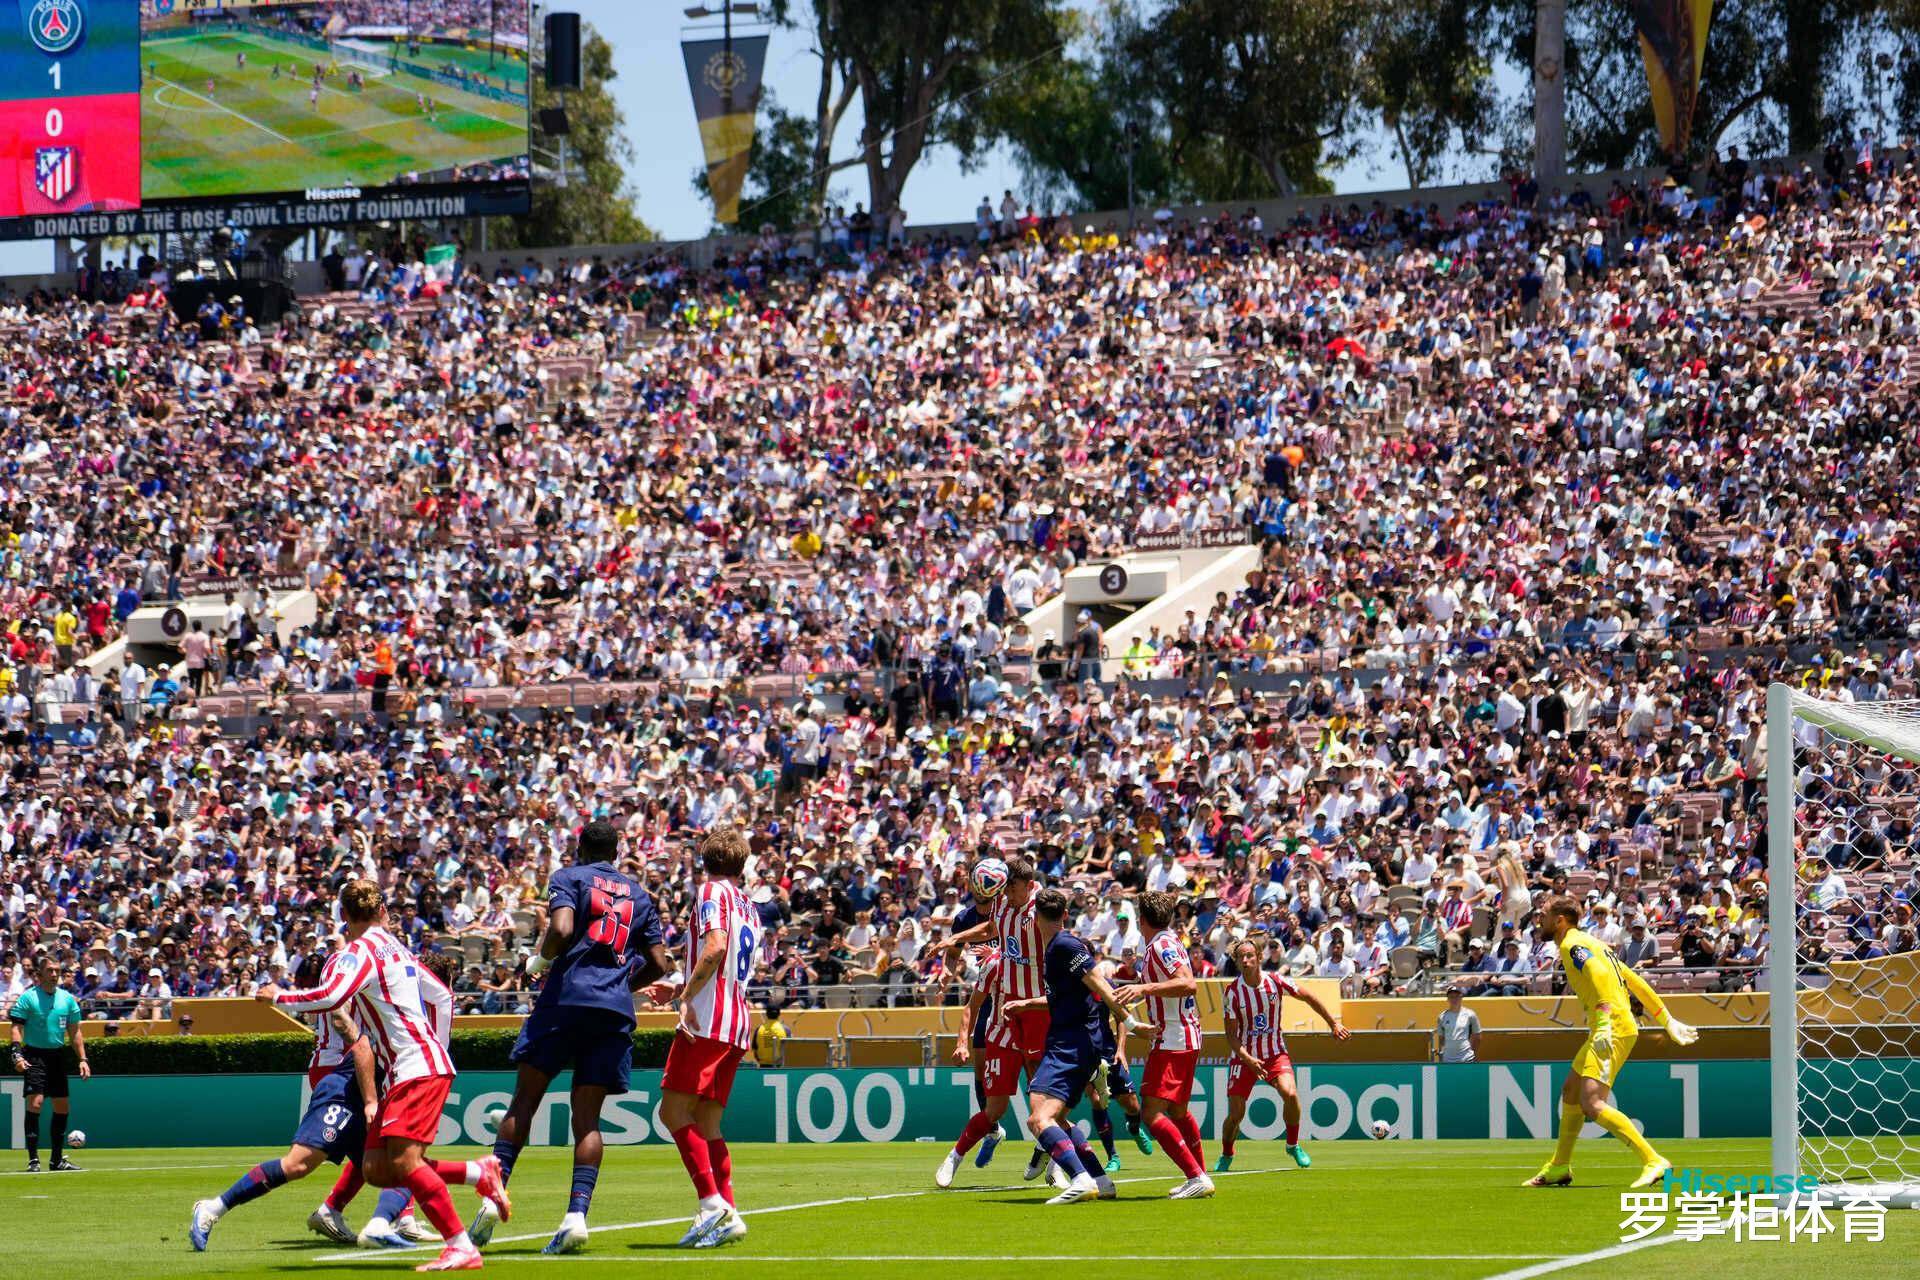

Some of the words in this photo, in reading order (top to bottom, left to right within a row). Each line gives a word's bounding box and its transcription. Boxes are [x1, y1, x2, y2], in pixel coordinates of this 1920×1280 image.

[48, 61, 61, 90] 1
[45, 108, 63, 136] 0
[305, 187, 361, 200] Hisense
[34, 214, 109, 237] DONATED
[116, 213, 138, 233] BY
[142, 211, 175, 231] THE
[181, 208, 224, 229] ROSE
[232, 205, 281, 227] BOWL
[286, 203, 351, 224] LEGACY
[357, 197, 466, 220] FOUNDATION
[1106, 571, 1121, 589] 3
[169, 613, 180, 631] 4
[588, 887, 634, 956] 51
[737, 924, 754, 982] 8
[984, 1058, 1000, 1077] 24
[323, 1104, 353, 1130] 87
[763, 1068, 936, 1143] 100"
[1669, 1063, 1700, 1138] 1
